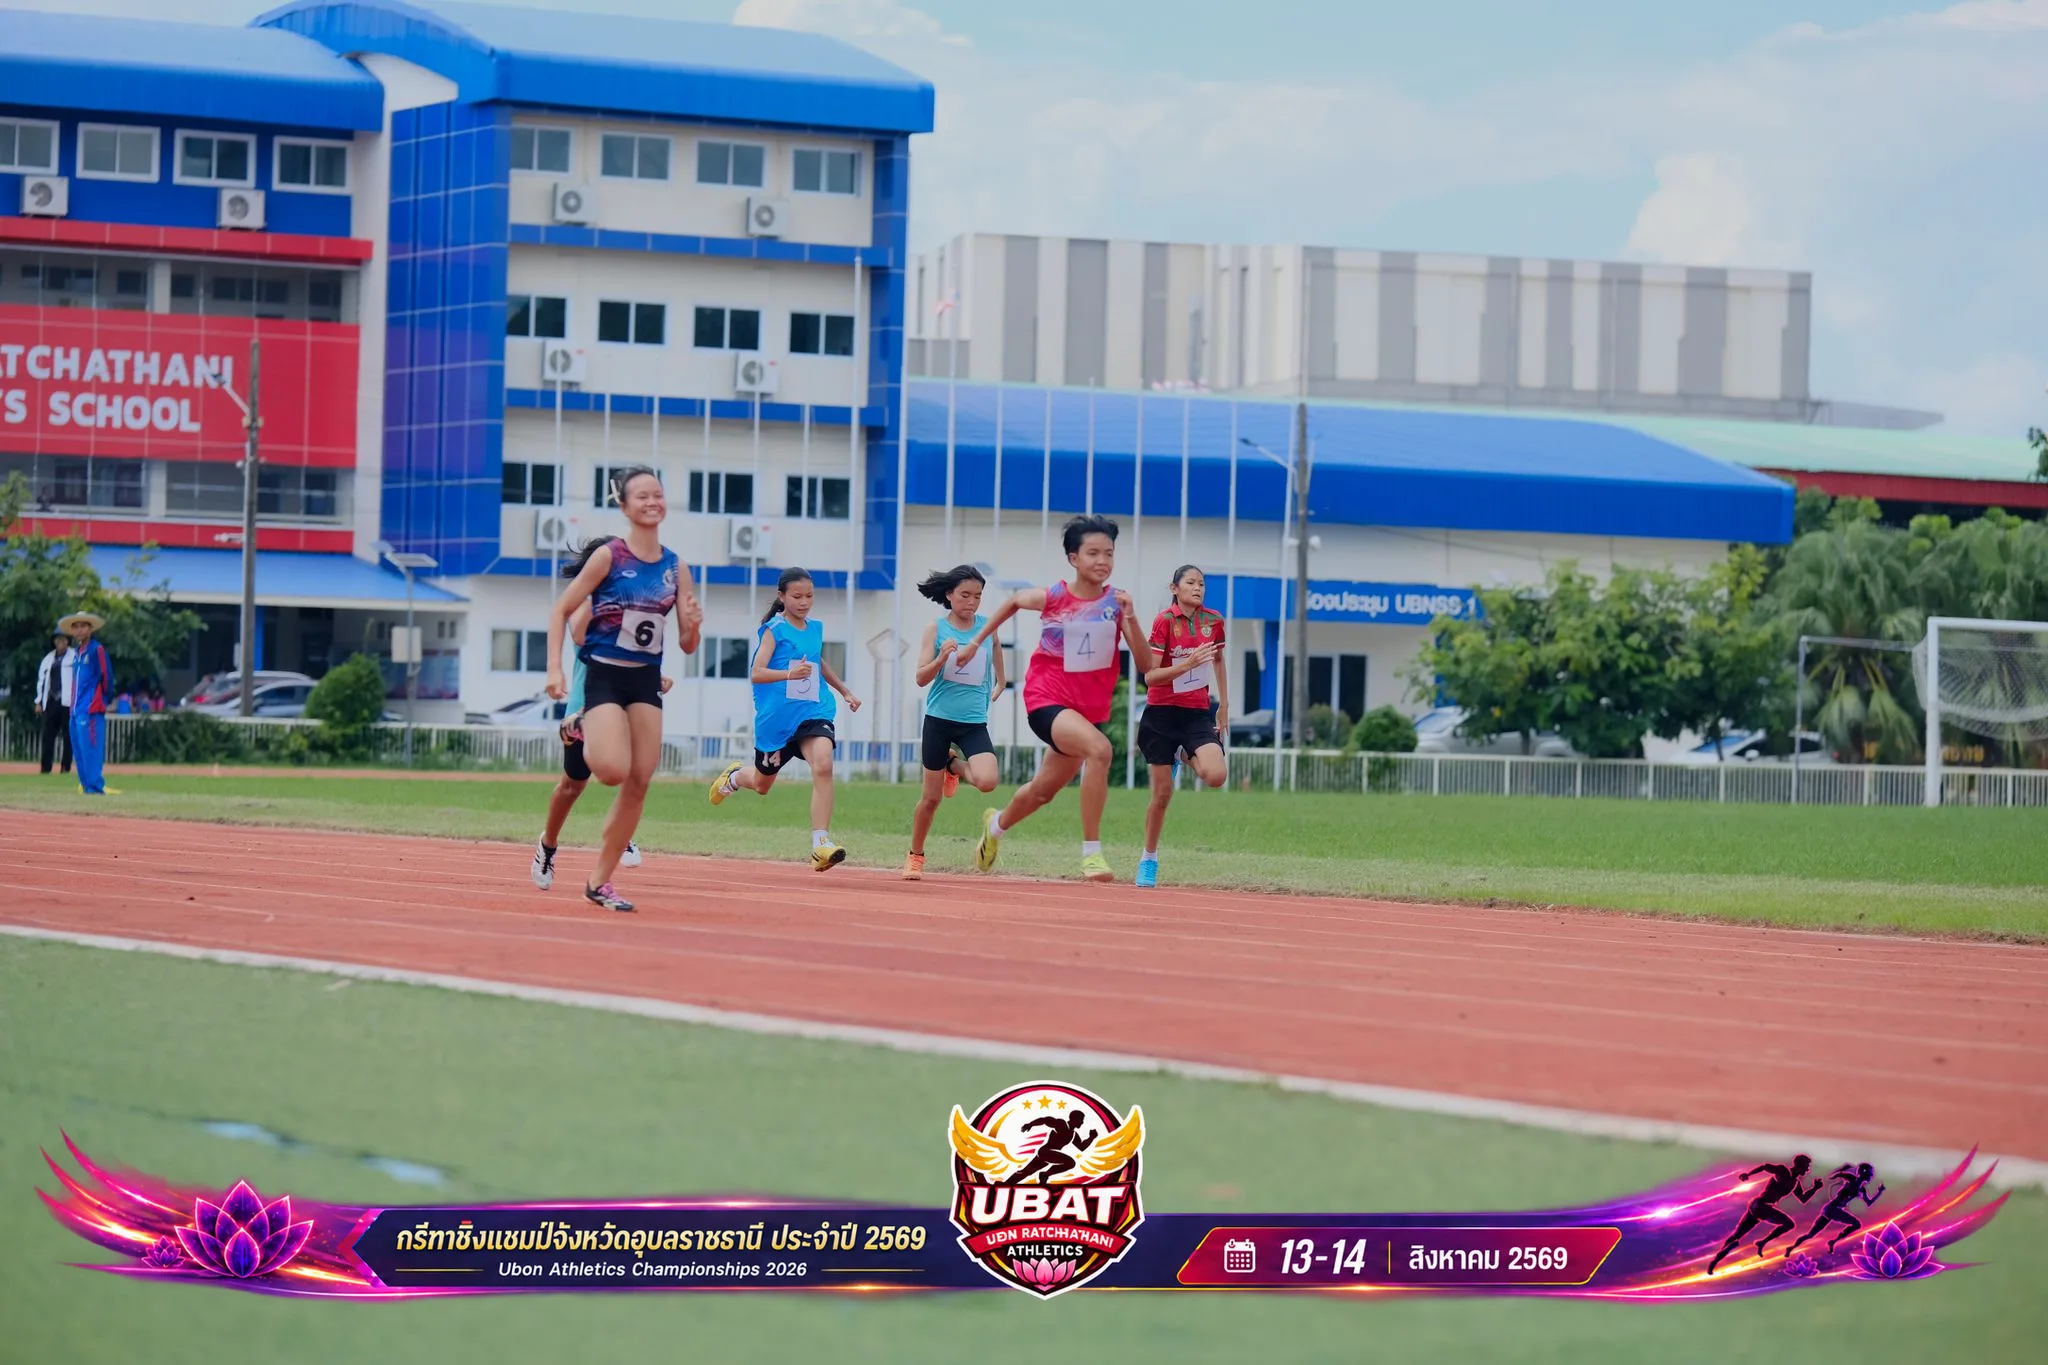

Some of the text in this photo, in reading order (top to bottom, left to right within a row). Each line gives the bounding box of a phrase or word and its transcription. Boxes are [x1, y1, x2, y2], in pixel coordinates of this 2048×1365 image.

[0, 344, 233, 389] TCHATHANI
[48, 391, 201, 433] SCHOOL
[635, 620, 656, 647] 6
[1077, 632, 1096, 661] 4
